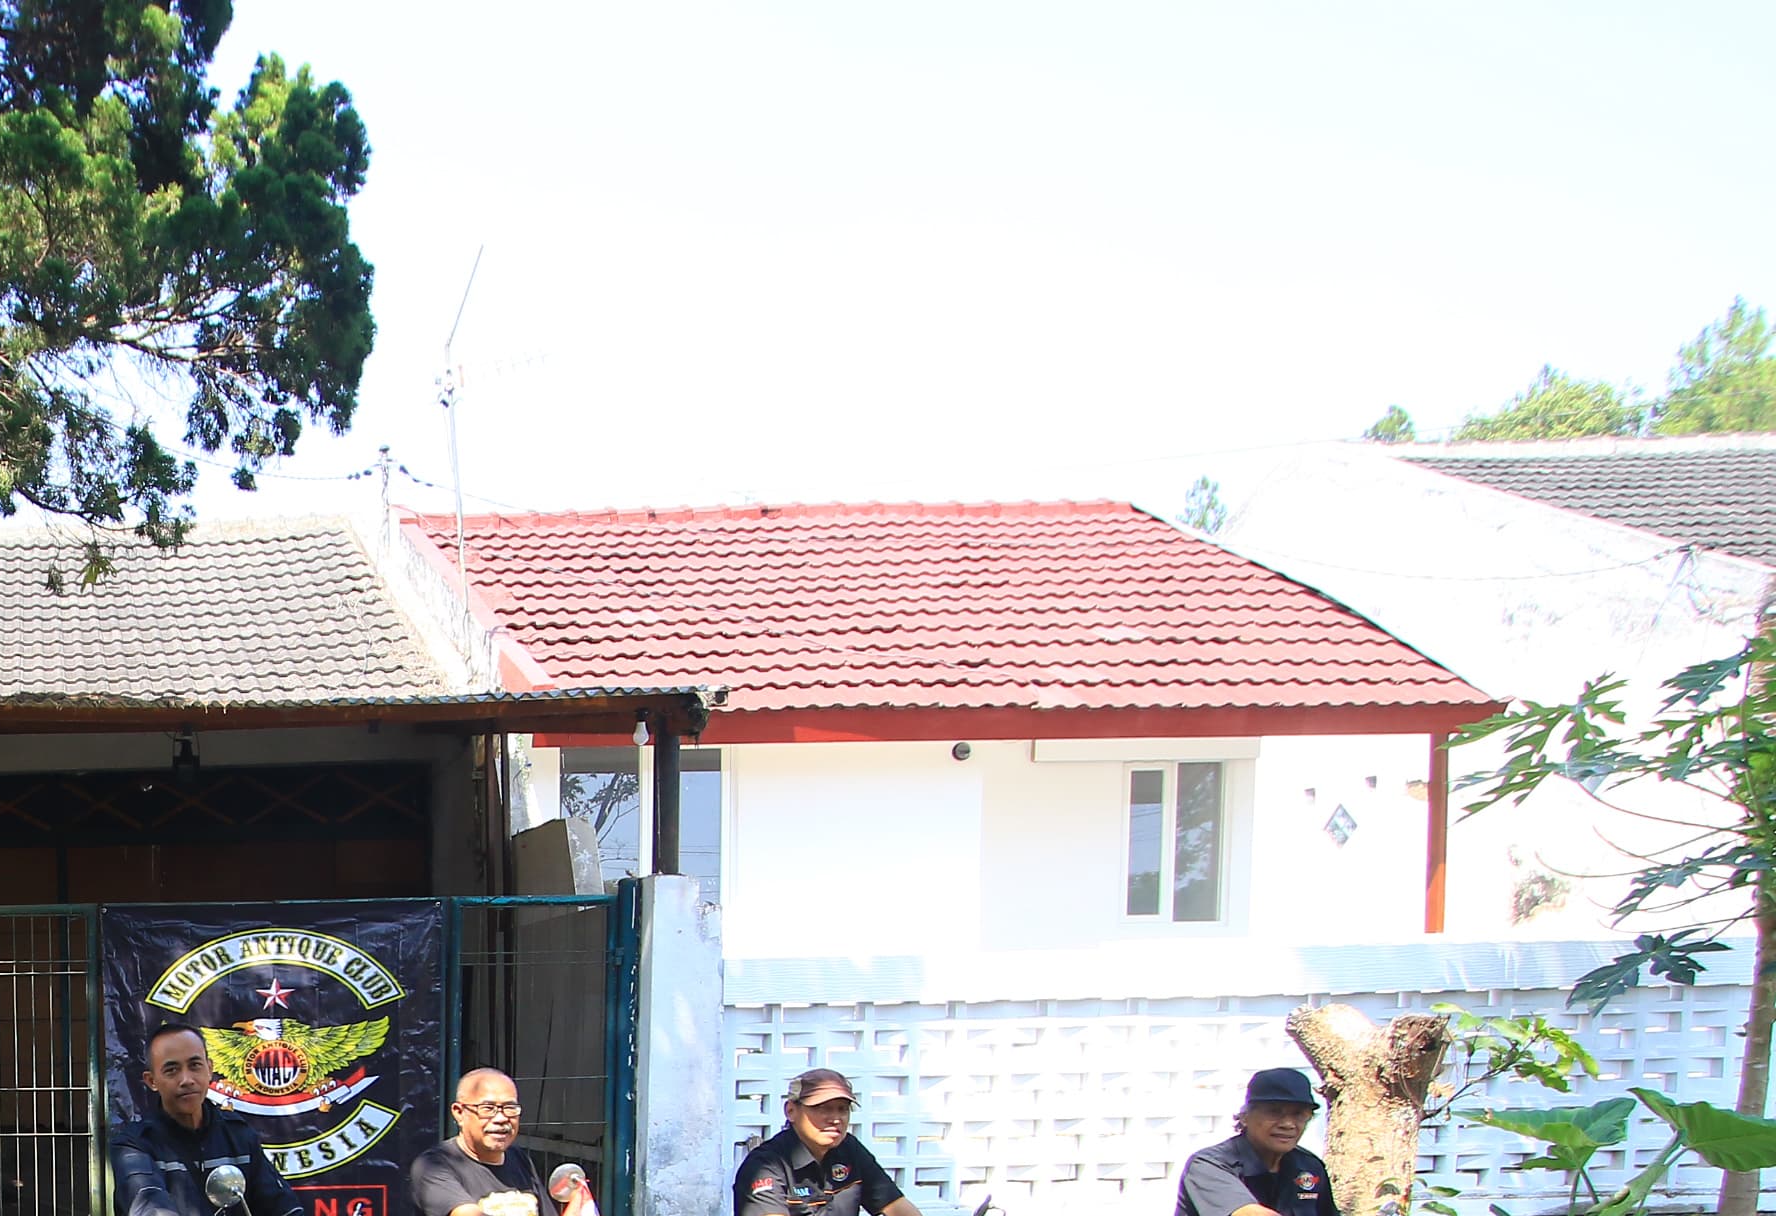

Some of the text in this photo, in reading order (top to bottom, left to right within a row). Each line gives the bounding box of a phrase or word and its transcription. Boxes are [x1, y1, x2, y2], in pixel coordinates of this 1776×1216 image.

[159, 935, 394, 1002] MOTOR ANTIQUE CLUB
[245, 1042, 307, 1075] MOTOR ANTIQUE CLUB
[255, 1083, 299, 1094] INDONESIA
[270, 1117, 379, 1172] NESIA
